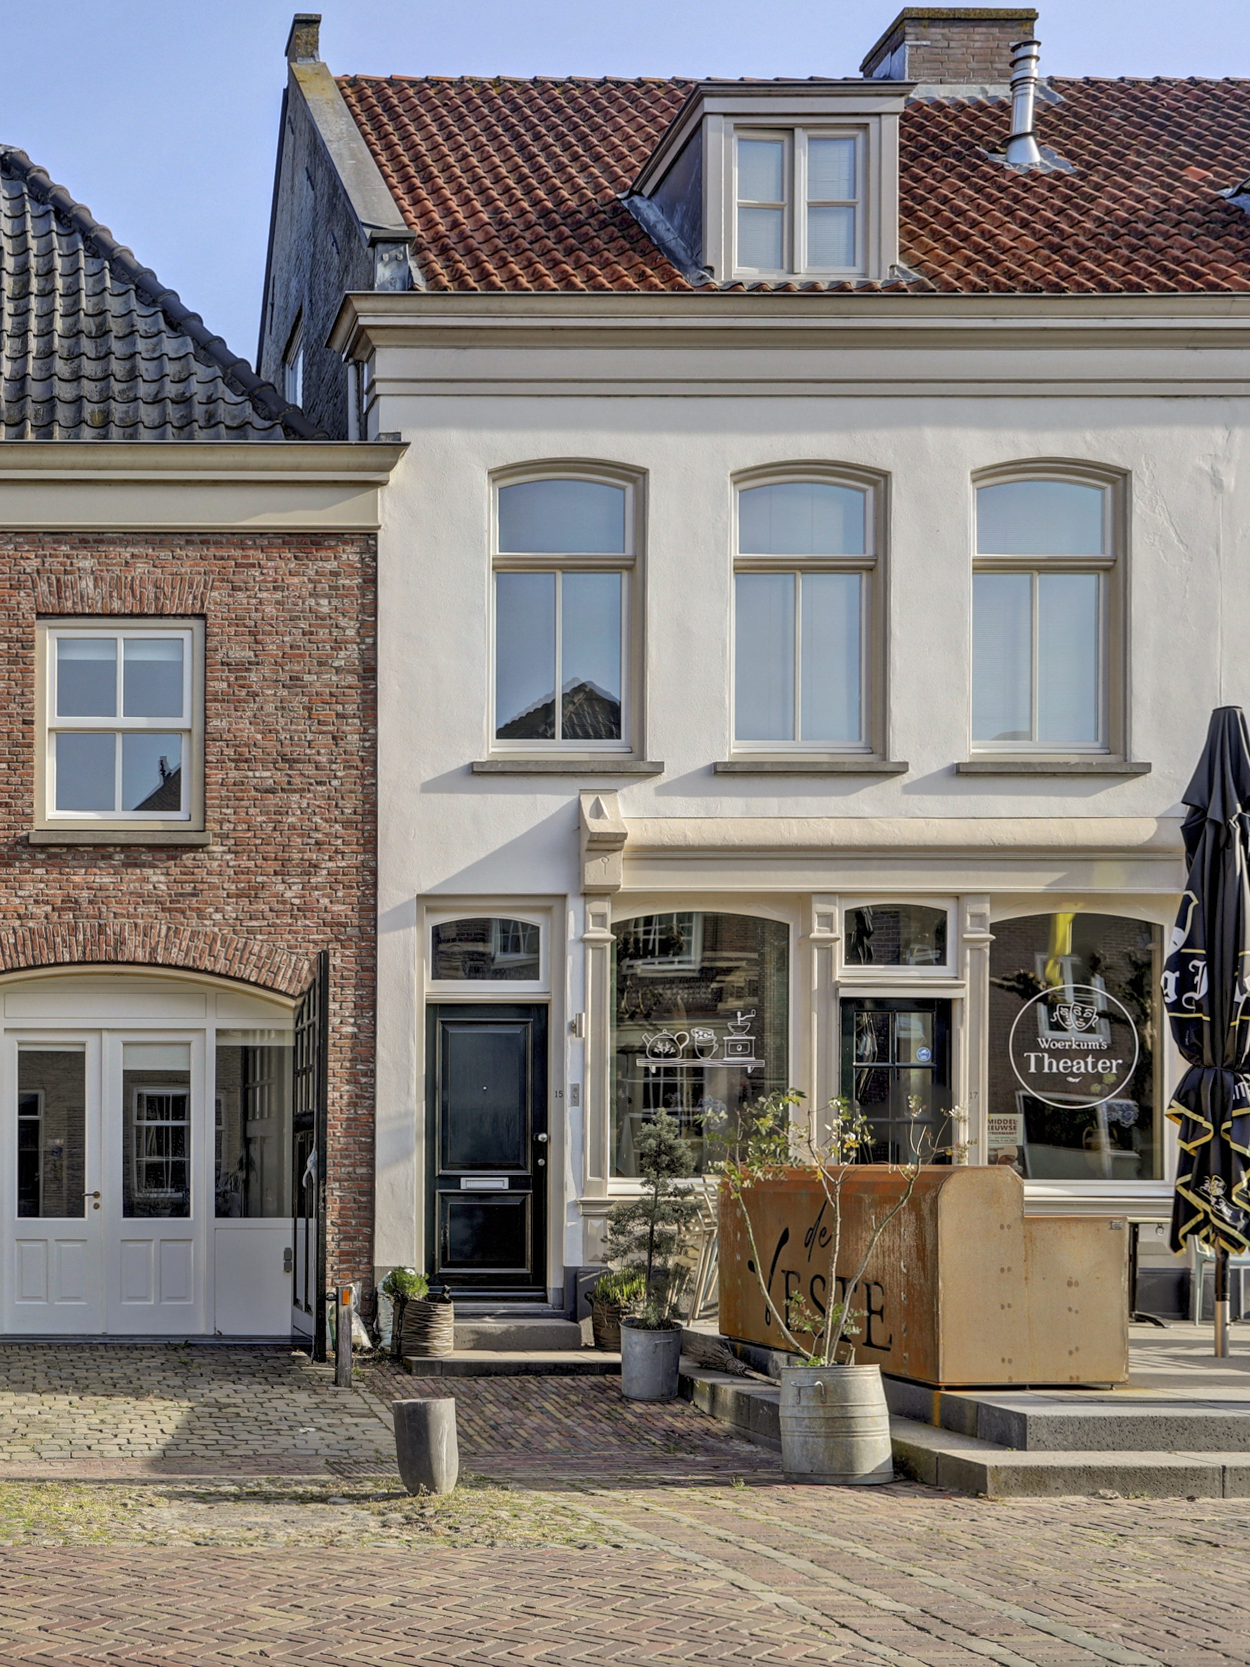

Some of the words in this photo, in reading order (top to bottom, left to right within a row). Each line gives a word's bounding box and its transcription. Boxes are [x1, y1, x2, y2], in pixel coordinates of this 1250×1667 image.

[1037, 1037, 1108, 1050] Woerkum's
[1023, 1052, 1123, 1074] Theater
[554, 1090, 564, 1099] 15
[969, 1091, 978, 1099] 17
[804, 1200, 833, 1263] de
